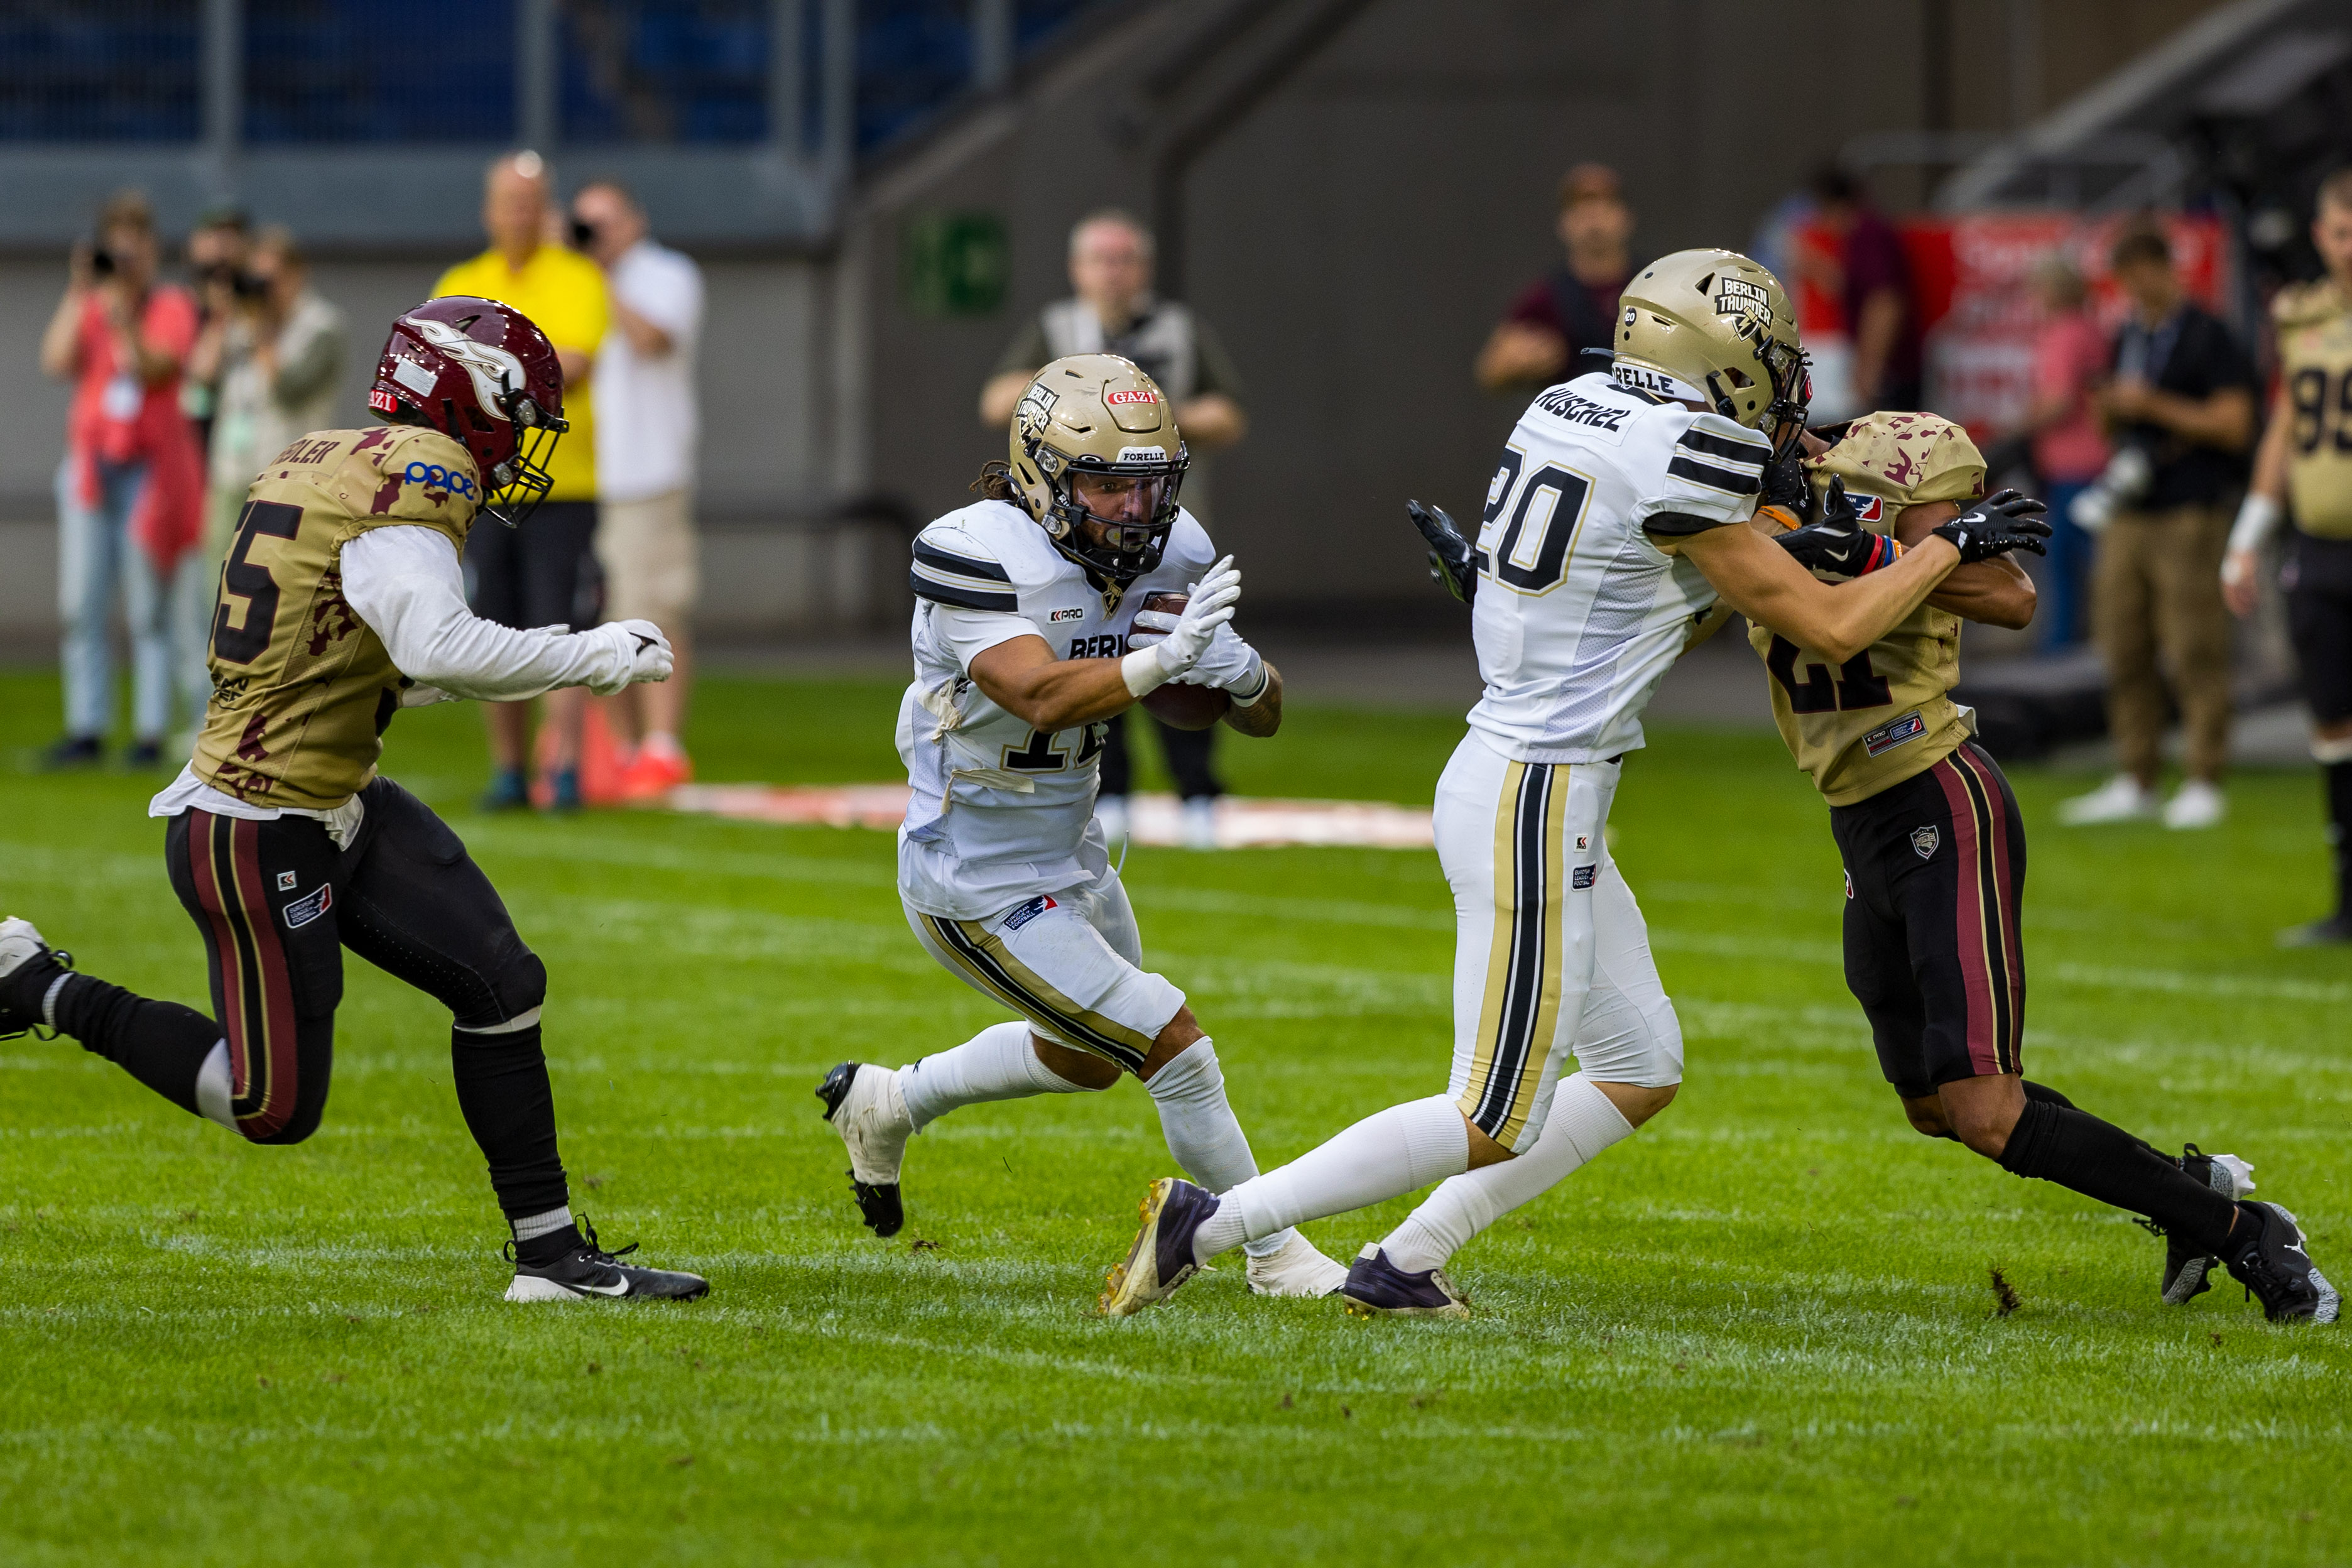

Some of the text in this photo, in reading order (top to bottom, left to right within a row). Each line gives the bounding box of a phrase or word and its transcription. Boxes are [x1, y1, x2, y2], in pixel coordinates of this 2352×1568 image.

[1724, 279, 1768, 306] BERLIN
[1719, 296, 1771, 327] THUNDER
[1612, 366, 1675, 395] RELLE
[368, 391, 393, 411] AZI
[1026, 384, 1057, 412] BERLIN
[1534, 388, 1631, 433] KUSCHEL
[1018, 400, 1048, 432] THUNDER
[1123, 452, 1165, 461] FORELLE
[1476, 441, 1596, 597] 20
[1005, 905, 1030, 925] EUROPEAN
[1008, 912, 1026, 927] LEAGUE
[1011, 912, 1036, 930] FOOTBALL
